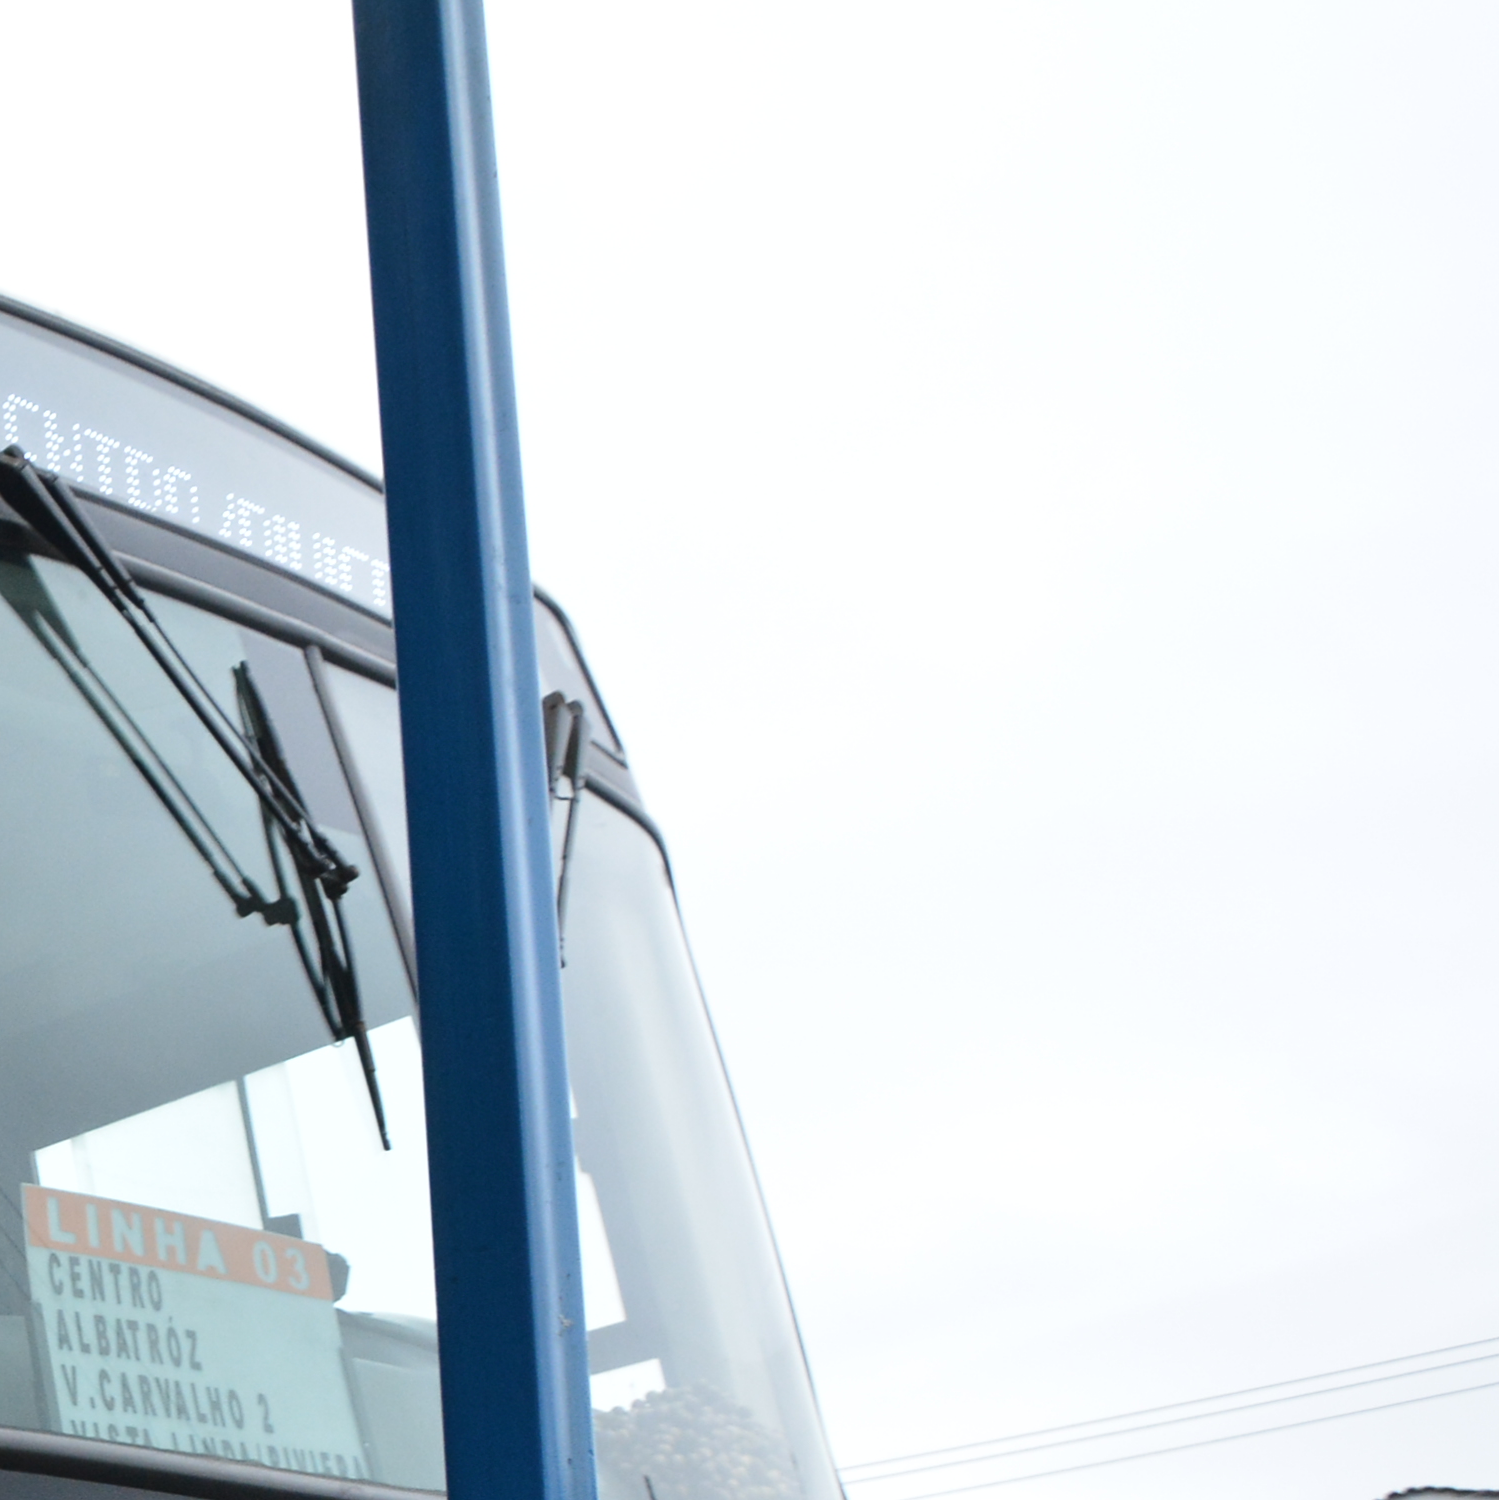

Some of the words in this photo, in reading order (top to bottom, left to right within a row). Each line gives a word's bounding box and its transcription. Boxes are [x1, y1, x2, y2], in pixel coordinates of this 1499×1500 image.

[46, 1196, 229, 1275] LINHA
[252, 1240, 311, 1291] 03
[48, 1253, 163, 1313] CENTRO
[56, 1309, 204, 1372] ALBATRÓZ
[60, 1363, 245, 1431] V.CARVALHO
[257, 1393, 276, 1434] 2
